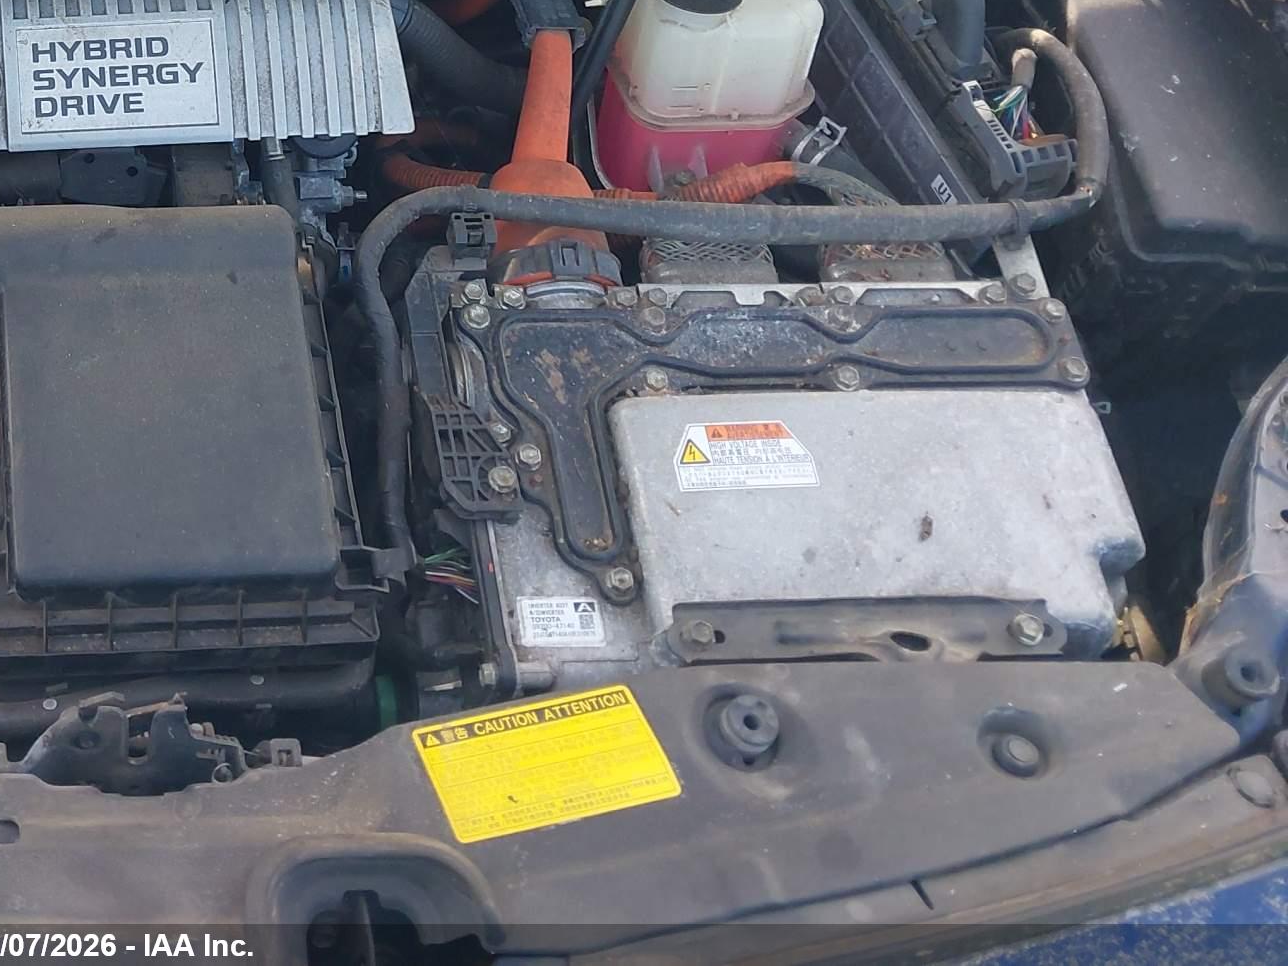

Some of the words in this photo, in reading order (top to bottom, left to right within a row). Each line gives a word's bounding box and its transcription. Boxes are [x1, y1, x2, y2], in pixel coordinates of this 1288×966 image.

[32, 36, 169, 63] HYBRID
[33, 62, 204, 91] SYNERGY
[34, 92, 145, 119] DRIVE
[474, 713, 539, 736] CAUTION
[544, 692, 626, 720] ATTENTION
